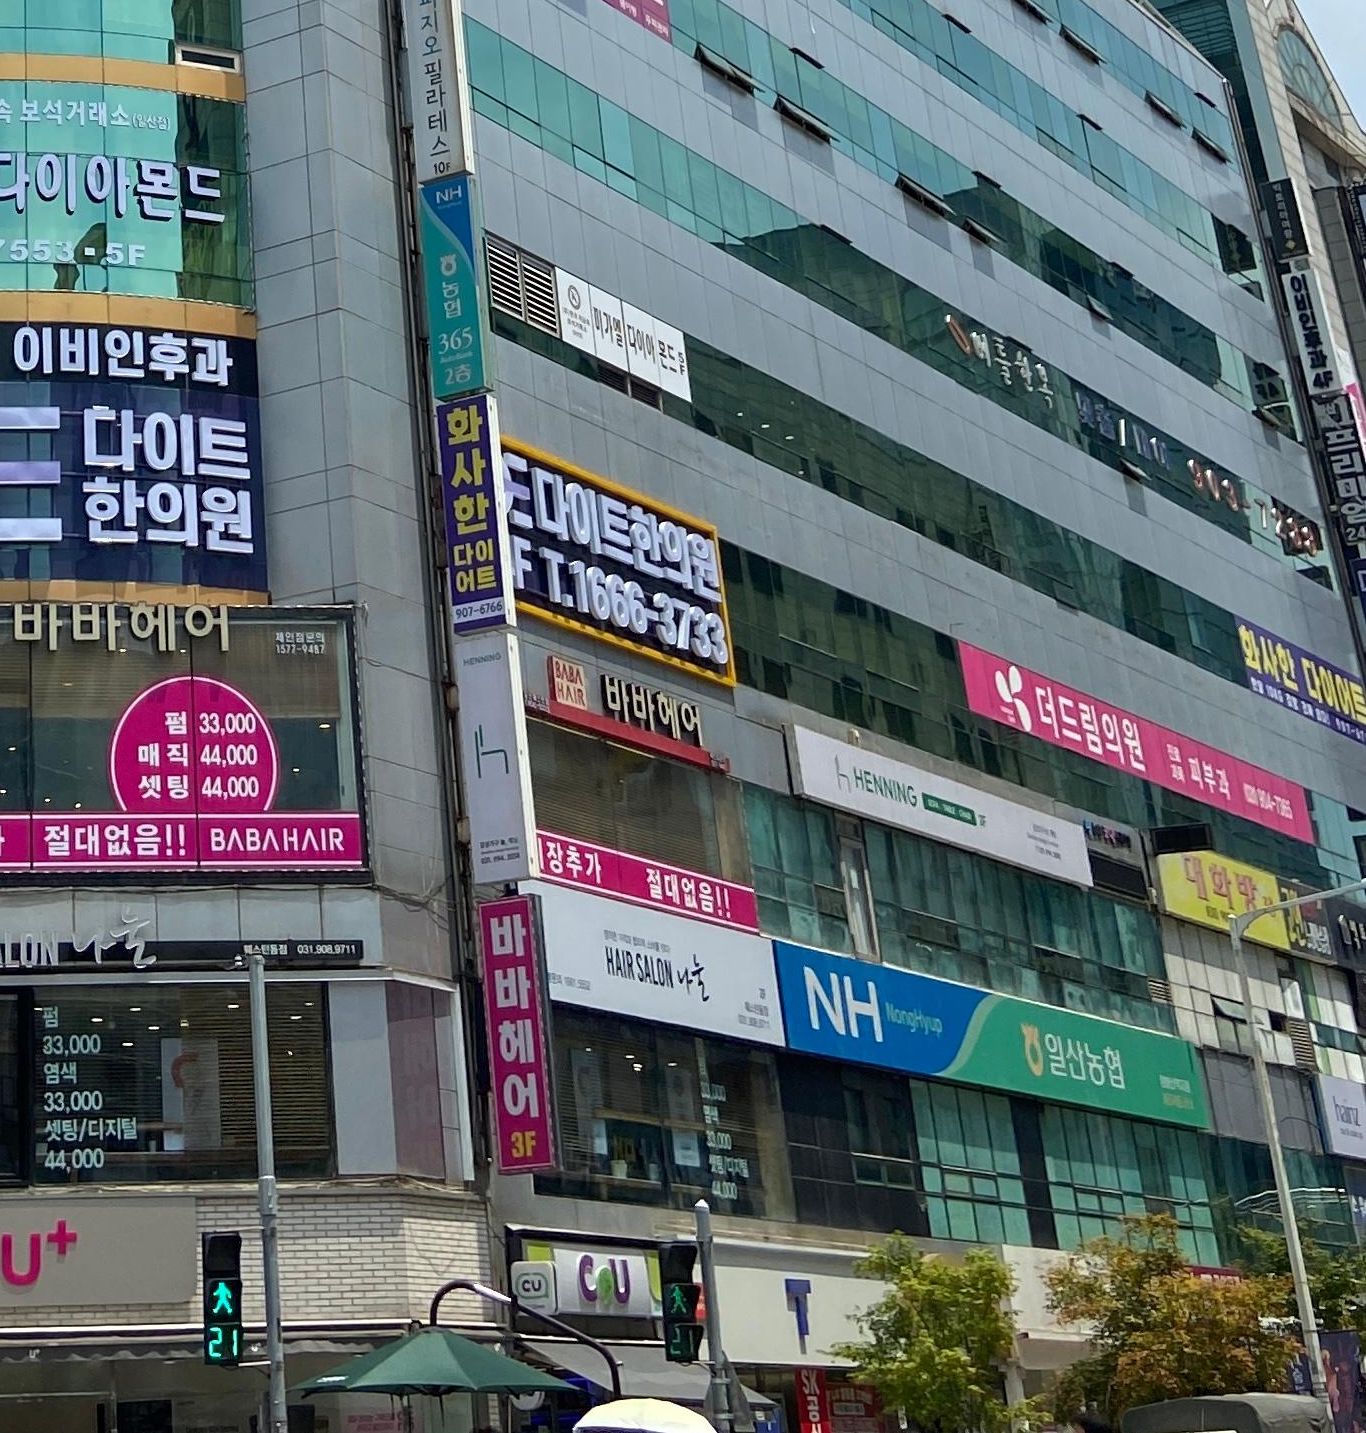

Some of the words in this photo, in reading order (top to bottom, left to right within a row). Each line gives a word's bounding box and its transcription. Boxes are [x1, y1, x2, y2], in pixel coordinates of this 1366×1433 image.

[433, 161, 452, 176] 10F
[435, 185, 463, 204] NH
[104, 242, 147, 267] 5F
[1289, 273, 1328, 368] 이비인후과
[438, 326, 474, 355] 365
[13, 325, 234, 387] 이비인후과
[1312, 370, 1335, 388] 4F
[83, 405, 252, 481] 다이트
[445, 404, 490, 536] 화사한
[82, 475, 255, 555] 한의원
[534, 466, 723, 604] 다이트한의원
[455, 601, 504, 620] 907-6766
[538, 546, 730, 666] T.1666-3733
[14, 603, 229, 651] 바바헤어
[463, 653, 502, 666] HENNING
[1238, 624, 1299, 692] 화사한
[553, 662, 584, 686] BABA
[556, 681, 586, 707] HAIR
[165, 712, 187, 733] 펌
[198, 712, 257, 735] 33,000
[604, 674, 703, 747] 바바헤어
[199, 744, 259, 767] 44,000
[1035, 685, 1147, 772] 더드림의원
[1188, 757, 1231, 801] 피부과
[200, 776, 260, 800] 44,000
[852, 767, 918, 808] HENNING
[604, 945, 635, 982] HAIR
[636, 952, 675, 990] SALON
[42, 1005, 60, 1029] 펌
[489, 913, 537, 1119] 바바헤어
[803, 964, 885, 1043] NH
[884, 1001, 943, 1038] NongHyup
[1044, 1031, 1127, 1090] 일산농협
[42, 1032, 102, 1057] 33,000
[42, 1060, 78, 1085] 염색
[42, 1089, 104, 1113] 33,000
[43, 1116, 139, 1145] 셋팅/디지털
[44, 1145, 106, 1171] 44,000
[510, 1131, 537, 1159] 3F
[521, 1278, 542, 1293] CU
[577, 1254, 631, 1305] CU
[208, 1329, 238, 1359] 21
[800, 1369, 820, 1397] SK
